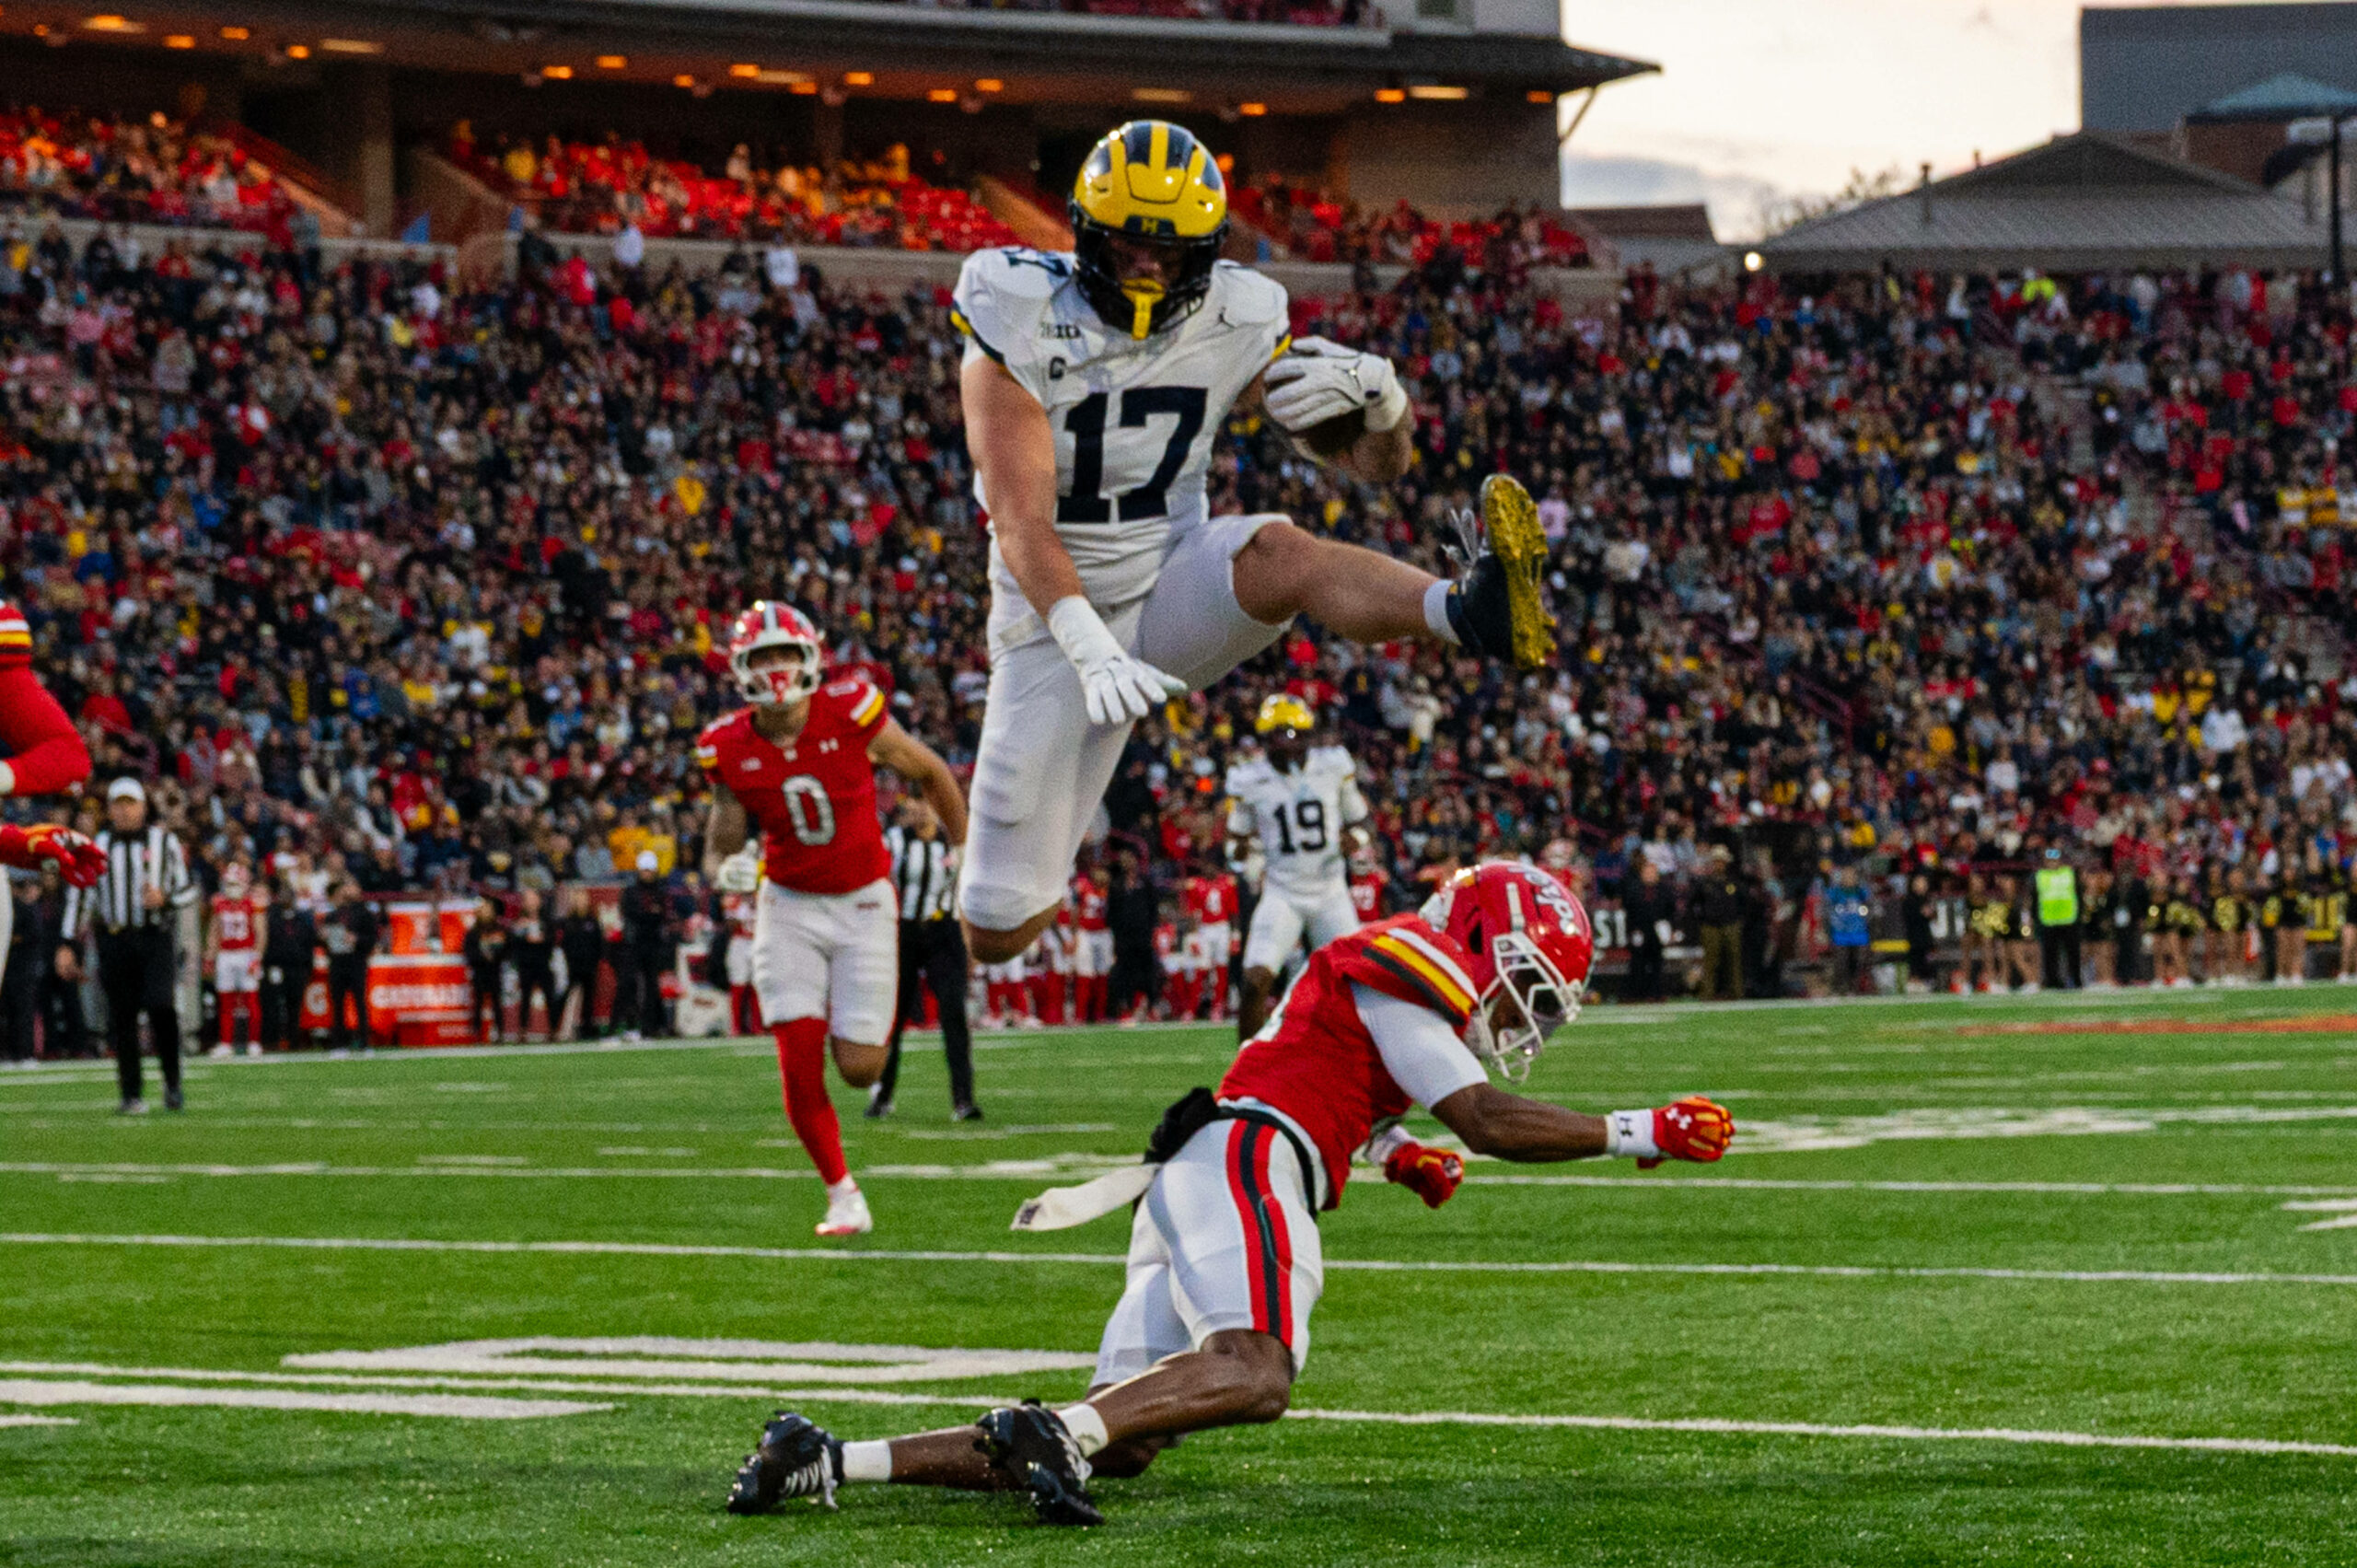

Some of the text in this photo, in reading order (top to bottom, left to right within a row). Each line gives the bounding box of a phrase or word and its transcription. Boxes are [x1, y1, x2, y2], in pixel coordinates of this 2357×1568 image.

[1049, 356, 1066, 380] C
[1057, 387, 1208, 523] 17
[781, 773, 836, 845] 0
[1273, 798, 1327, 854] 19
